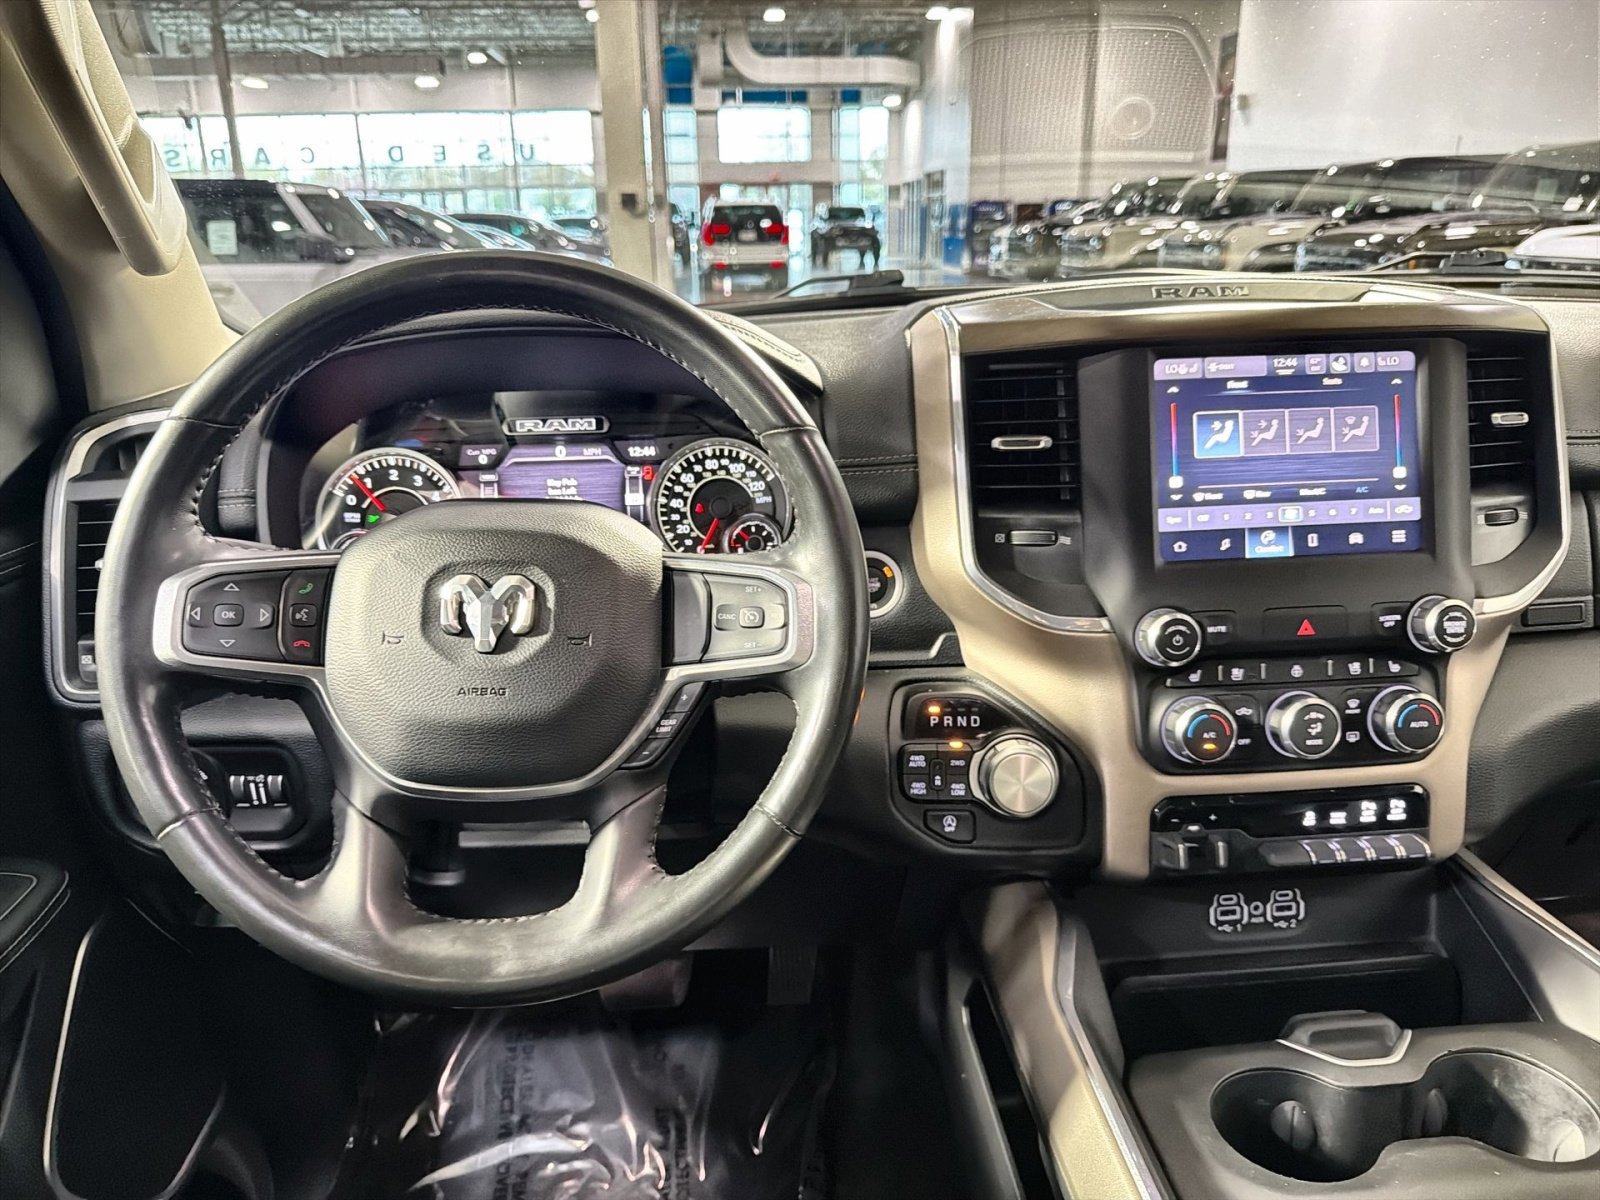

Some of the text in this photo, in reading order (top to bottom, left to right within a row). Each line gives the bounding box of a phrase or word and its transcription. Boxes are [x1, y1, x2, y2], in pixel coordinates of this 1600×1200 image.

[1151, 285, 1249, 298] RAM
[1273, 357, 1298, 368] 12:44
[515, 418, 597, 432] RAM
[627, 445, 656, 456] 12:44
[704, 459, 719, 470] 80
[728, 463, 746, 473] 100
[388, 469, 400, 481] 2
[412, 474, 424, 487] 3
[680, 472, 695, 484] 60
[363, 477, 373, 489] 1
[747, 480, 766, 492] 120
[345, 494, 357, 506] 0
[669, 498, 684, 508] 40
[676, 524, 690, 534] 20
[221, 610, 236, 619] OK
[717, 613, 736, 621] CANC
[1207, 625, 1228, 633] MUTE
[456, 687, 508, 697] AIRBAG
[930, 716, 980, 727] P R N D
[1409, 720, 1429, 728] AUTO
[1290, 918, 1297, 928] 2
